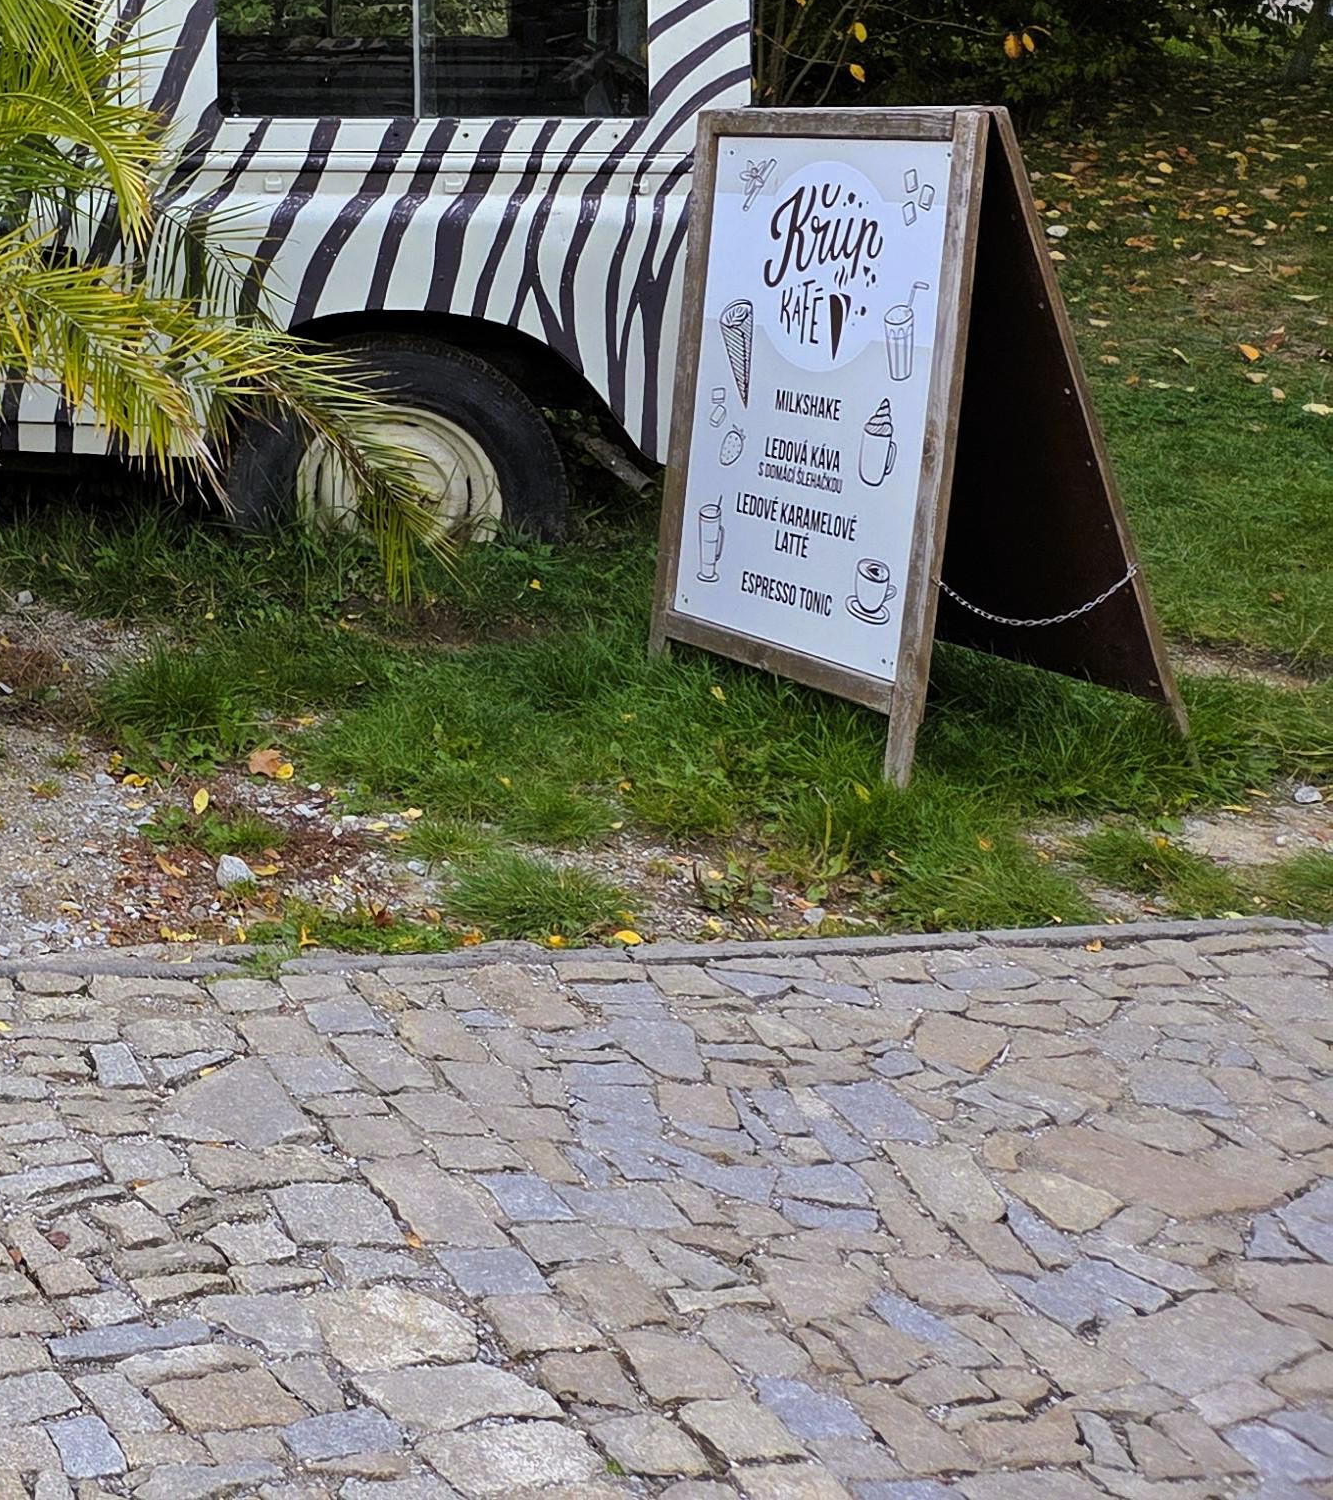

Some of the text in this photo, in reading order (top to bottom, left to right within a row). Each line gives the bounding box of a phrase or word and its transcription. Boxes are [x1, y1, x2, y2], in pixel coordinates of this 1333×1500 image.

[775, 389, 841, 420] MILKSHAKE
[765, 437, 839, 472] LEDOVÁ KÁVA
[758, 462, 843, 494] S DOMÁCÍ ŠLEHAČKOU
[737, 492, 857, 541] LEDOVÉ KARAMELOVÉ
[775, 530, 809, 558] LATTÉ
[741, 571, 832, 616] ESPRESSO TONIC
